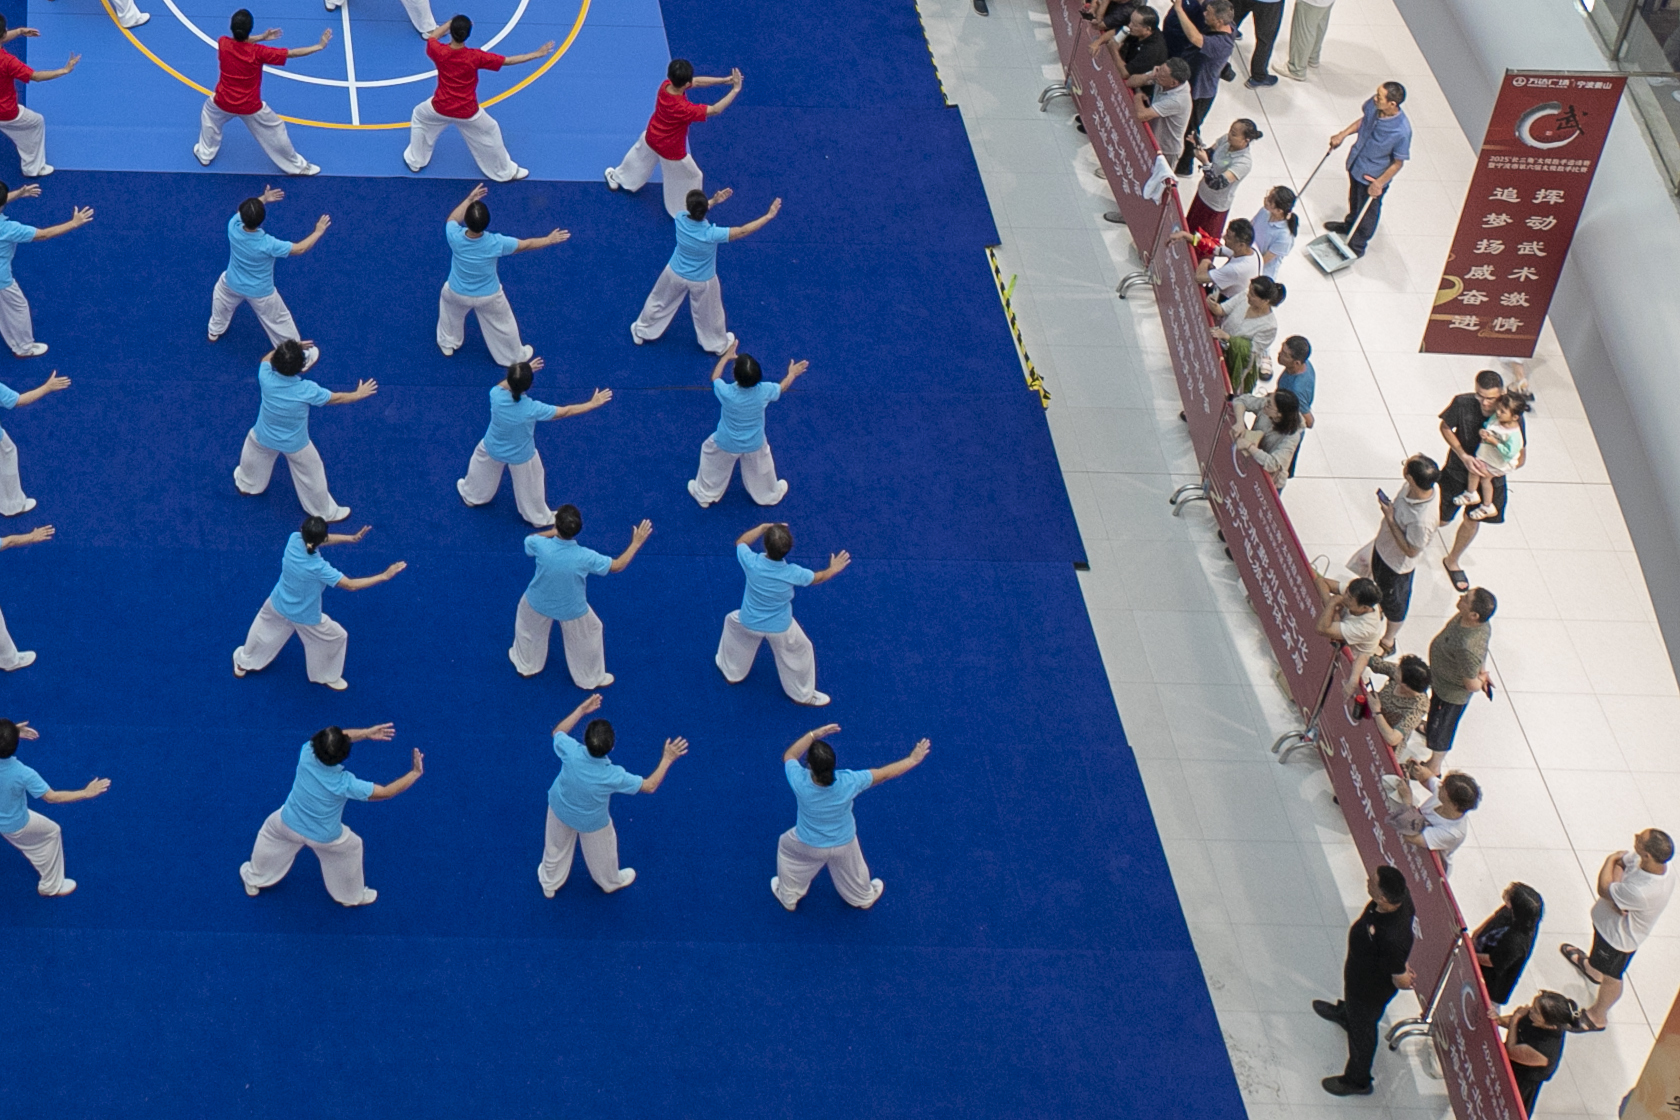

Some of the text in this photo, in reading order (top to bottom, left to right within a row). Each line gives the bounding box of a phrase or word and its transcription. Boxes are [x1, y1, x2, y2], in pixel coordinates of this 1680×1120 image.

[1449, 187, 1521, 331] 追梦扬威奋进
[1492, 189, 1565, 333] 挥动武术激情
[1228, 474, 1310, 665] 宁波市鄞州区文化
[1446, 997, 1487, 1119] 宁波市北
